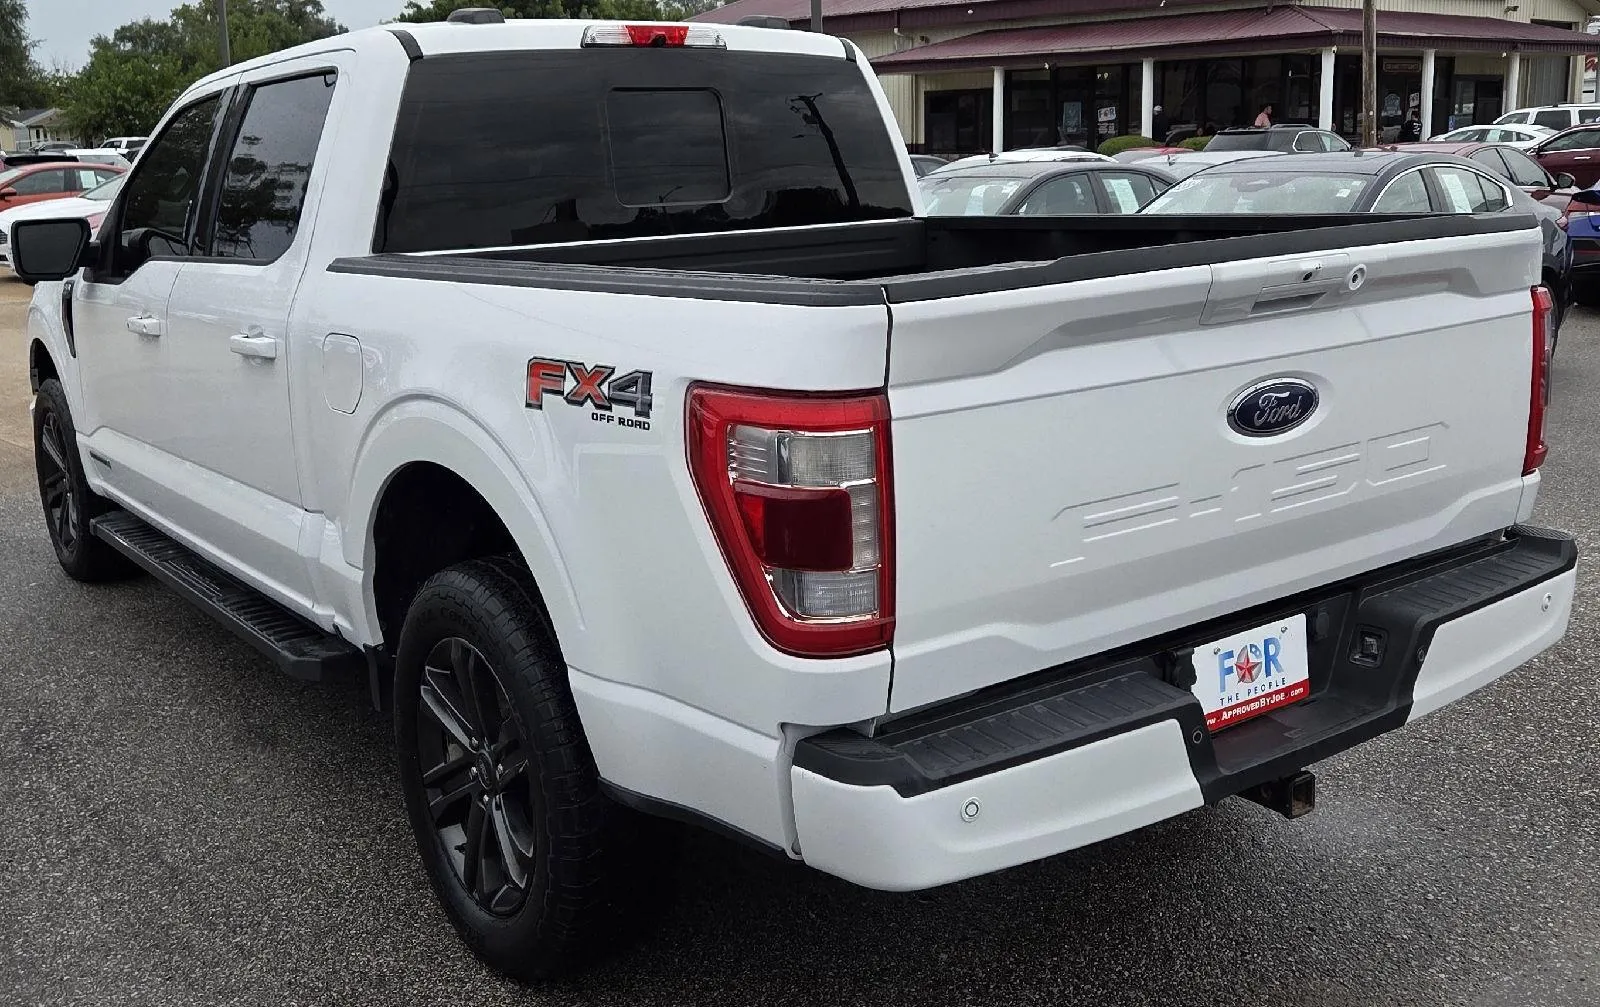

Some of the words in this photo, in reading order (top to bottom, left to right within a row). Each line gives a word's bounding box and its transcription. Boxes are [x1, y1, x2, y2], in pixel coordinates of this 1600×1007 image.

[525, 356, 653, 419] FX4
[1253, 391, 1303, 427] Ford
[591, 412, 615, 424] OFF
[618, 416, 651, 431] ROAD
[1049, 421, 1450, 568] F-150
[1217, 637, 1284, 693] FOR
[1219, 692, 1240, 706] THE
[1247, 677, 1286, 695] PEOPLE
